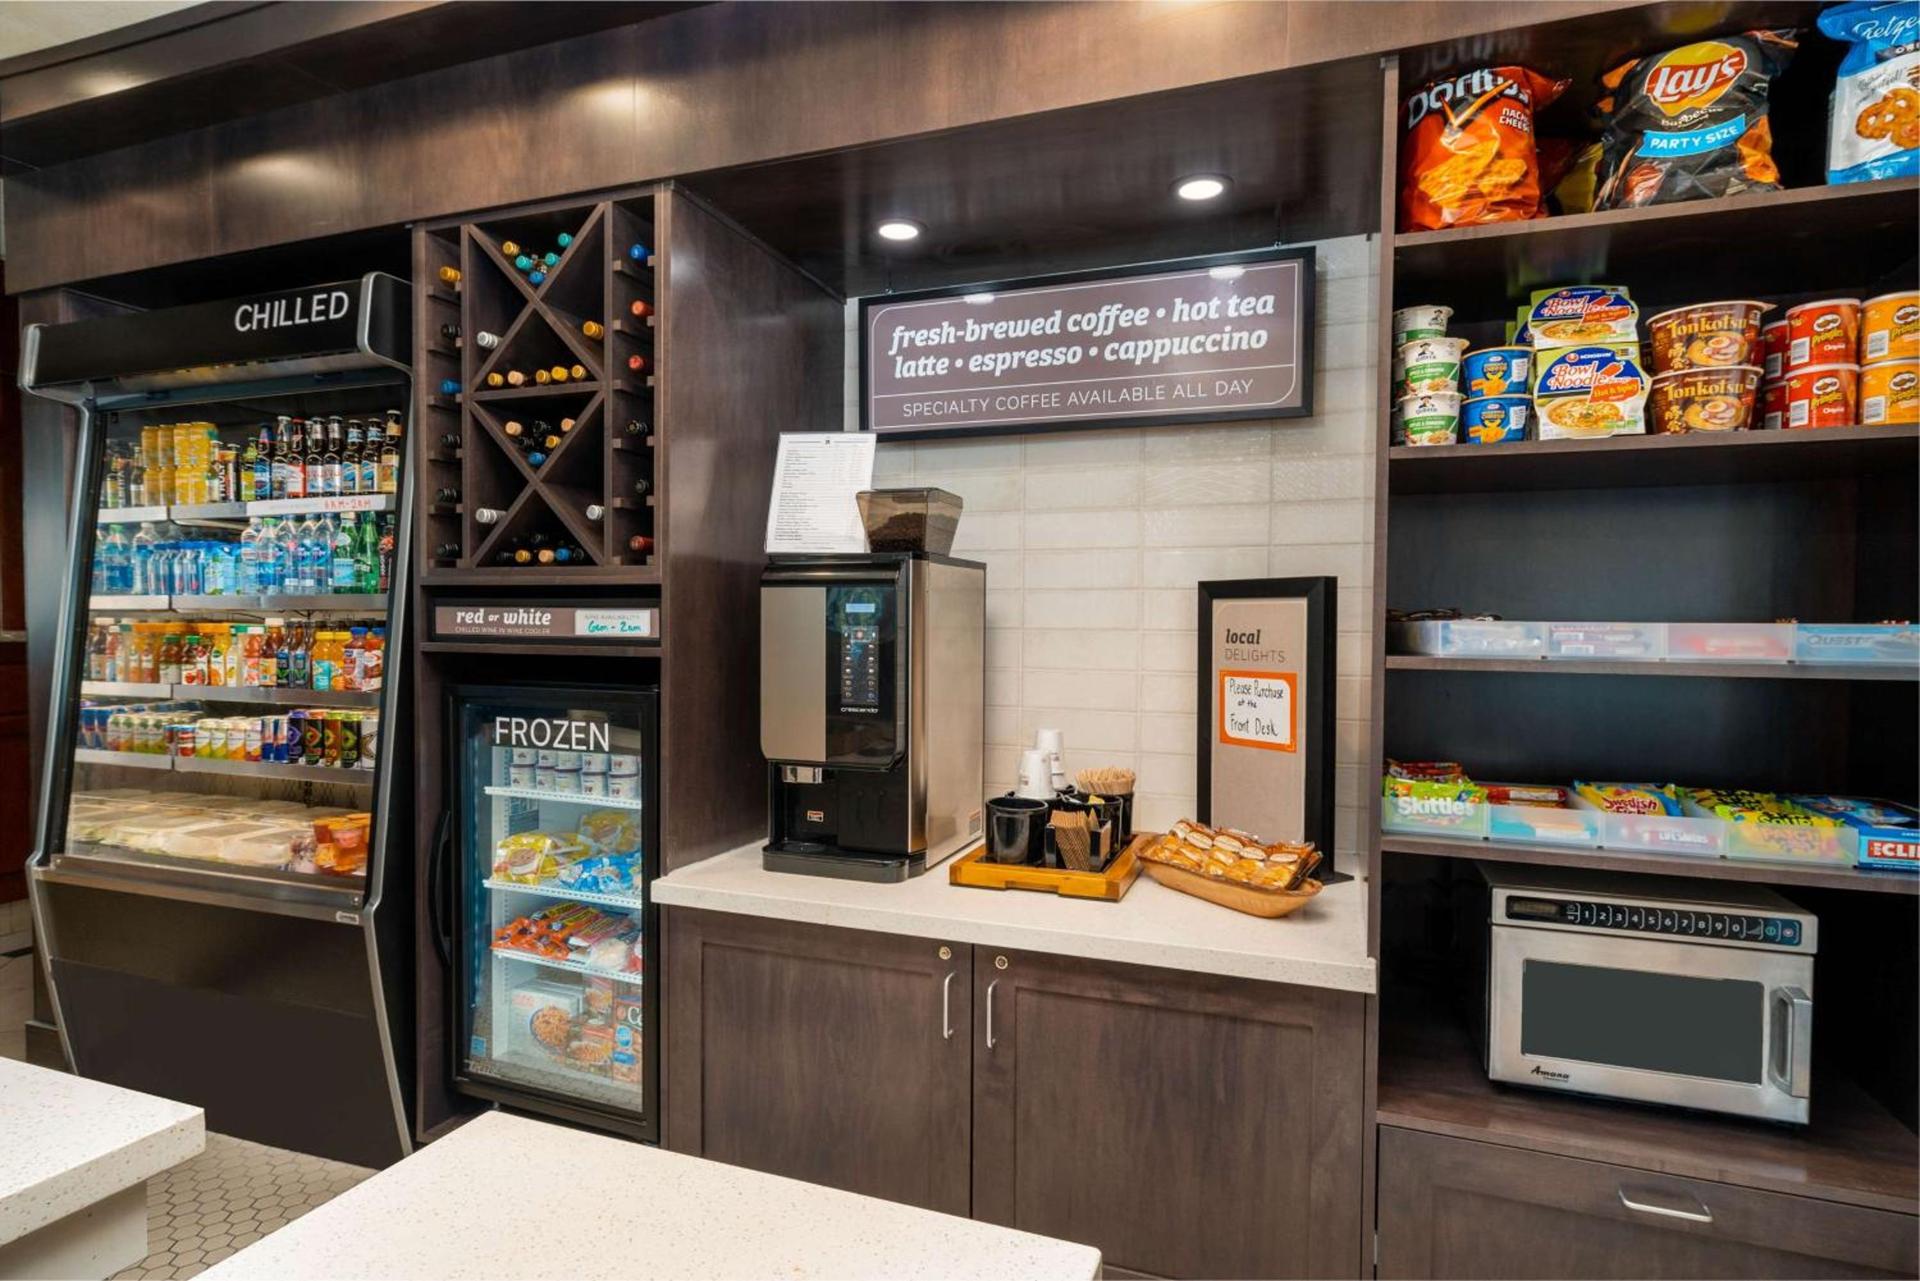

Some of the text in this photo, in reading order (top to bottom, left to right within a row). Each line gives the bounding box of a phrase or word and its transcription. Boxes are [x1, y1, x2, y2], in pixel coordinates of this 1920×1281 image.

[1653, 54, 1740, 103] Lay's
[1650, 125, 1739, 149] PARTY SIZE
[234, 290, 350, 333] CHILLED
[889, 293, 1275, 356] fresh-brewed coffee hot tea
[1667, 314, 1748, 338] Tonkotsu
[894, 326, 1269, 379] latte espresso cappuccino
[1552, 361, 1598, 377] Bowl
[1546, 374, 1606, 391] Noodle
[1663, 379, 1744, 402] Tonkotsu
[902, 379, 1255, 418] SPECIALTY COFFEE AVAILABLE ALL DAY
[456, 608, 552, 626] red or white
[588, 620, 609, 634] 6am
[620, 621, 642, 633] 2am
[1225, 628, 1262, 645] local
[1224, 648, 1286, 663] DELIGHTS
[1229, 678, 1285, 700] Please Purchase
[494, 716, 610, 752] FROZEN
[1230, 713, 1279, 737] Front Desk
[1397, 796, 1475, 817] Skittles
[1601, 796, 1658, 810] Swedish
[1873, 841, 1920, 859] ECLI
